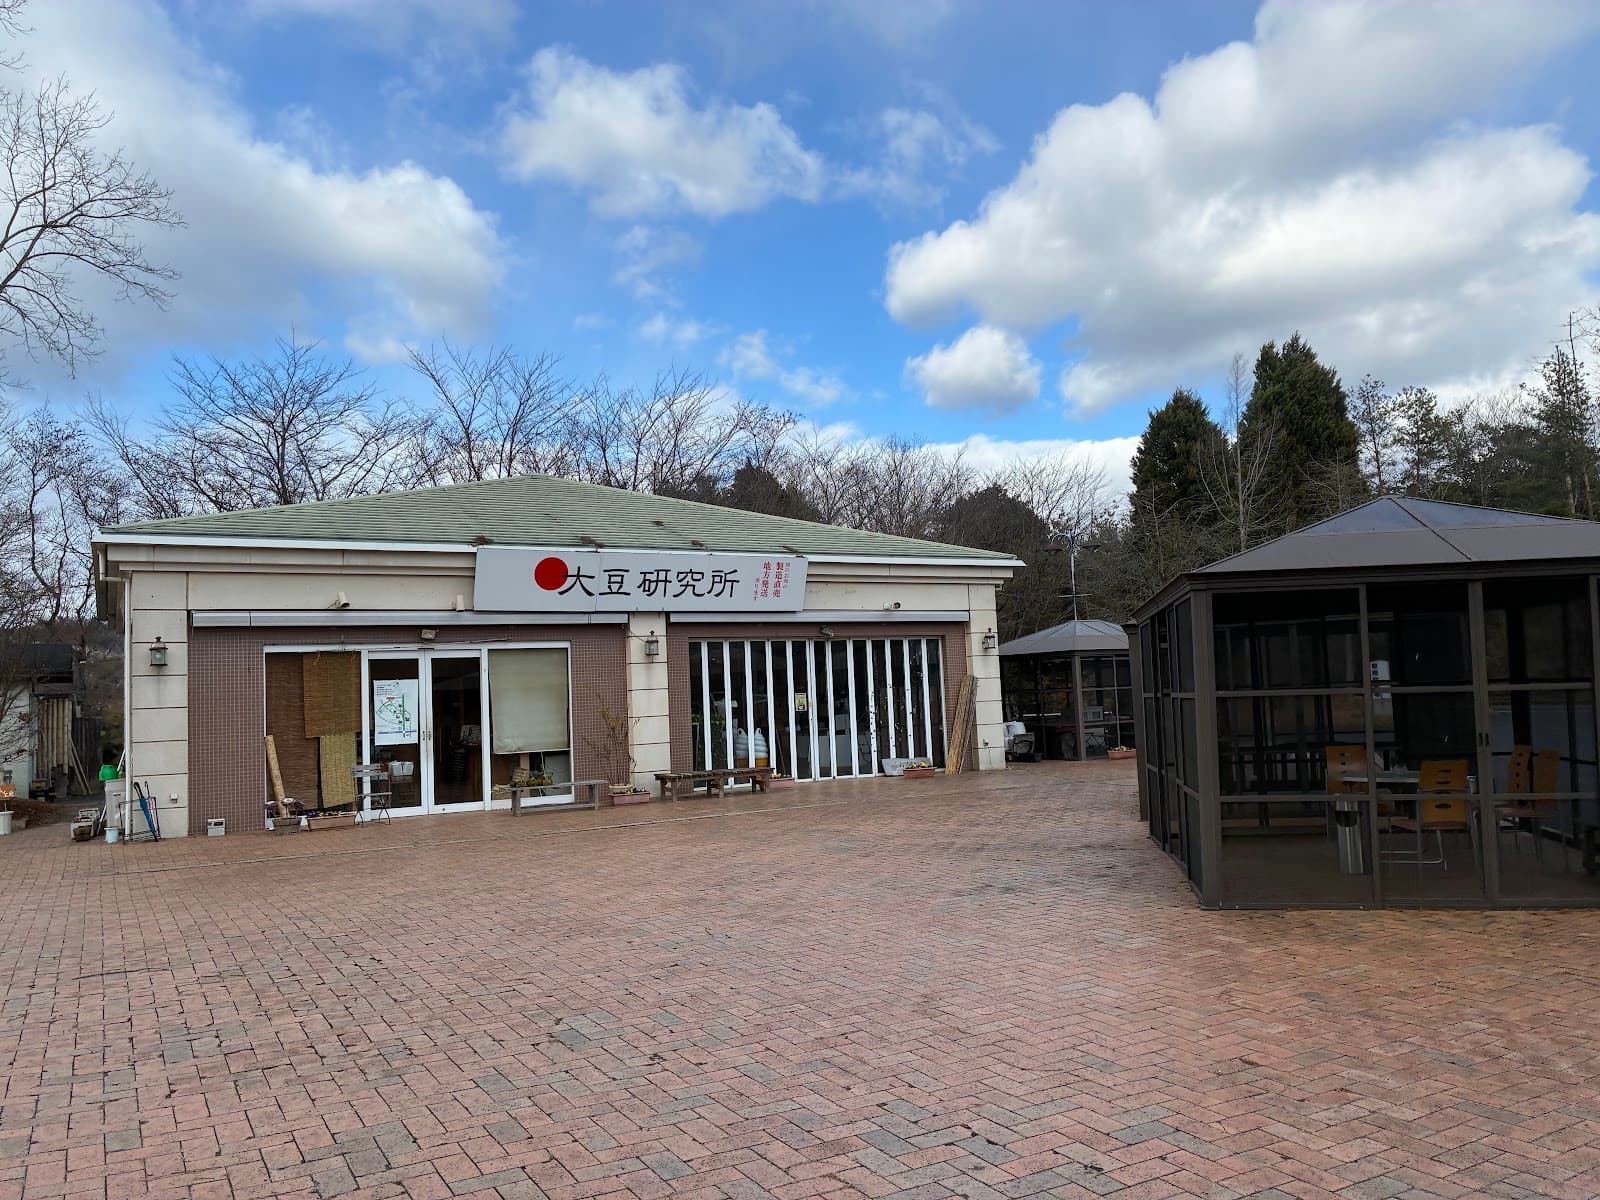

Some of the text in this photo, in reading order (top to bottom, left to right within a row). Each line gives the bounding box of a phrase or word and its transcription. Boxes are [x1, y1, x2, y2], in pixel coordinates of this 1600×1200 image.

[558, 566, 740, 598] 大豆研究所
[760, 560, 771, 598] 地方発送
[772, 561, 784, 598] 製造直売
